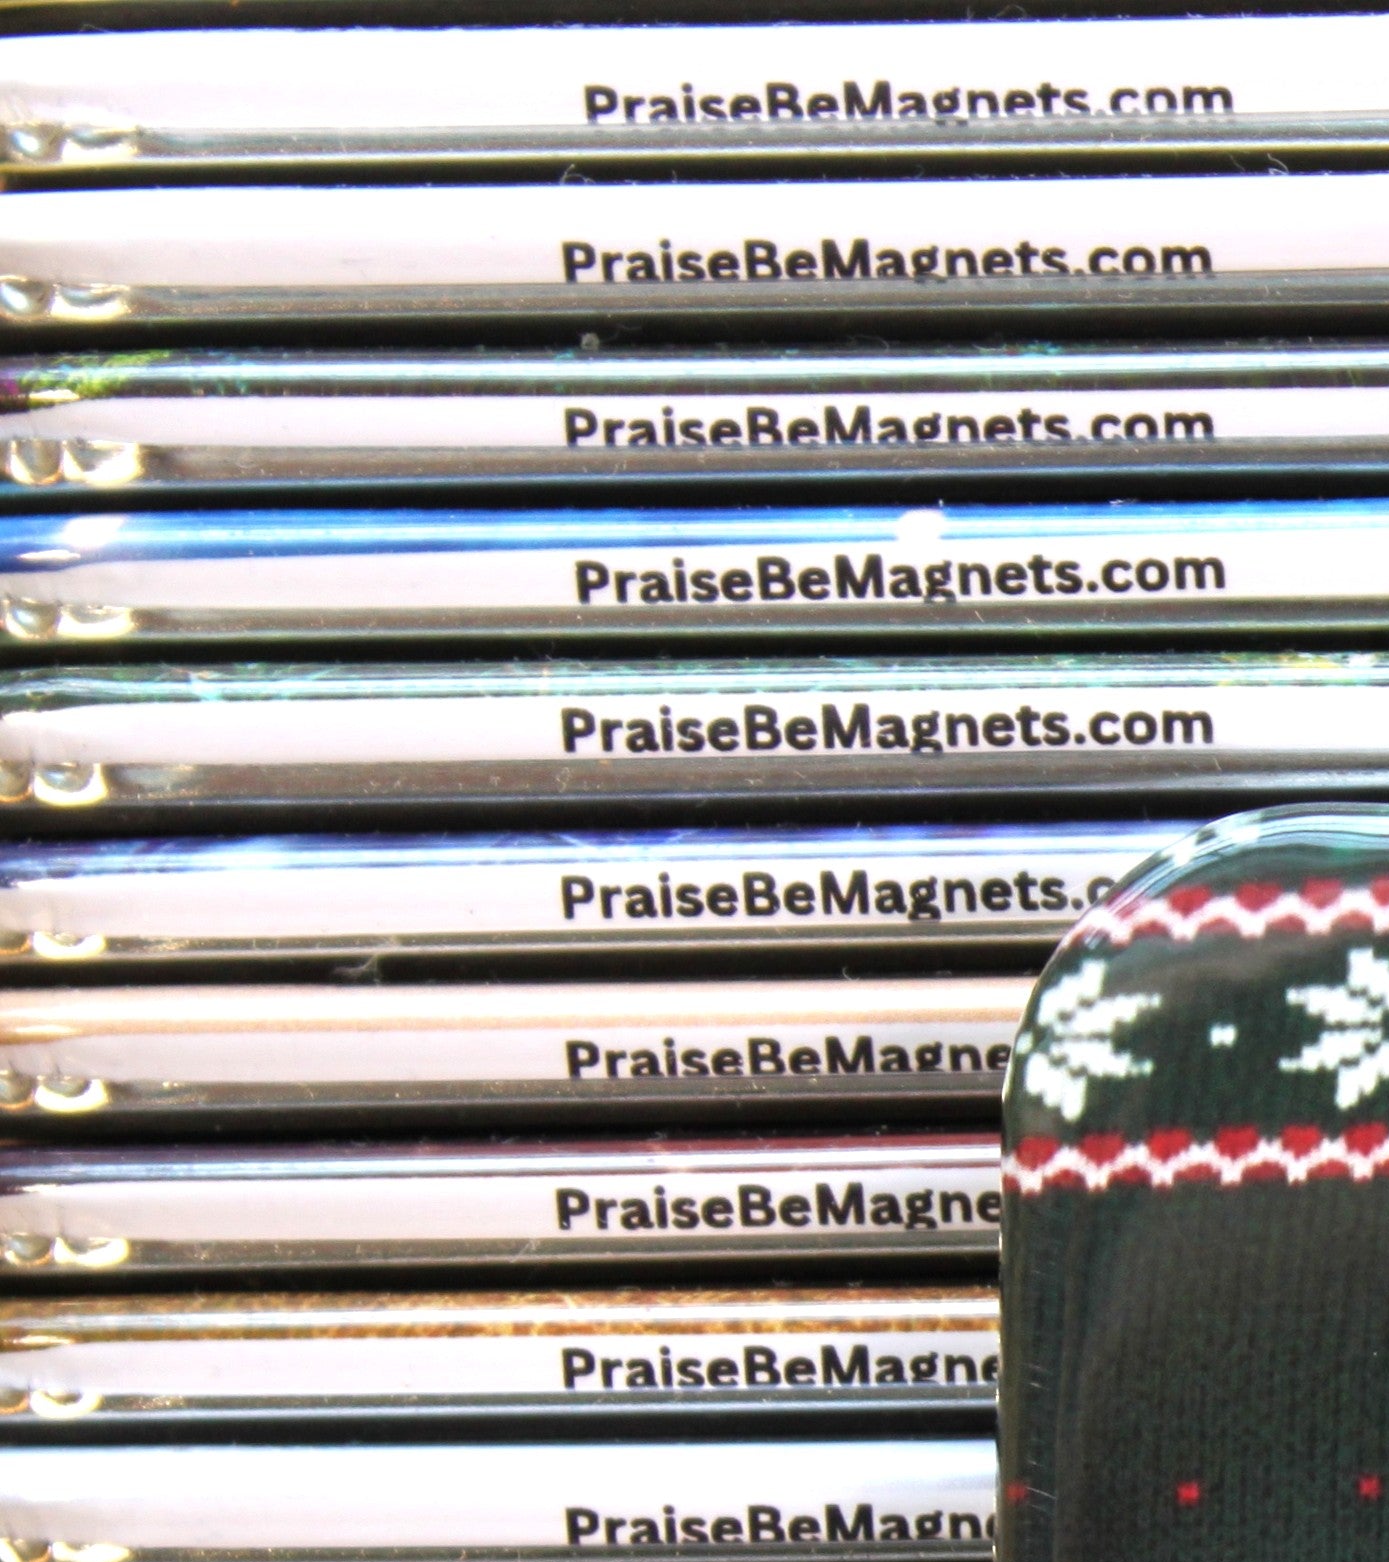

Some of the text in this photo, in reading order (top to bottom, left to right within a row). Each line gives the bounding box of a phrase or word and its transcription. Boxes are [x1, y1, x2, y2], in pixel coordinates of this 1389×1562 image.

[562, 238, 1212, 283] PraiseBeMagnets.com
[575, 554, 1225, 604] PraiseBeMagnets.com
[561, 704, 1213, 753] PraiseBeMagnets.com
